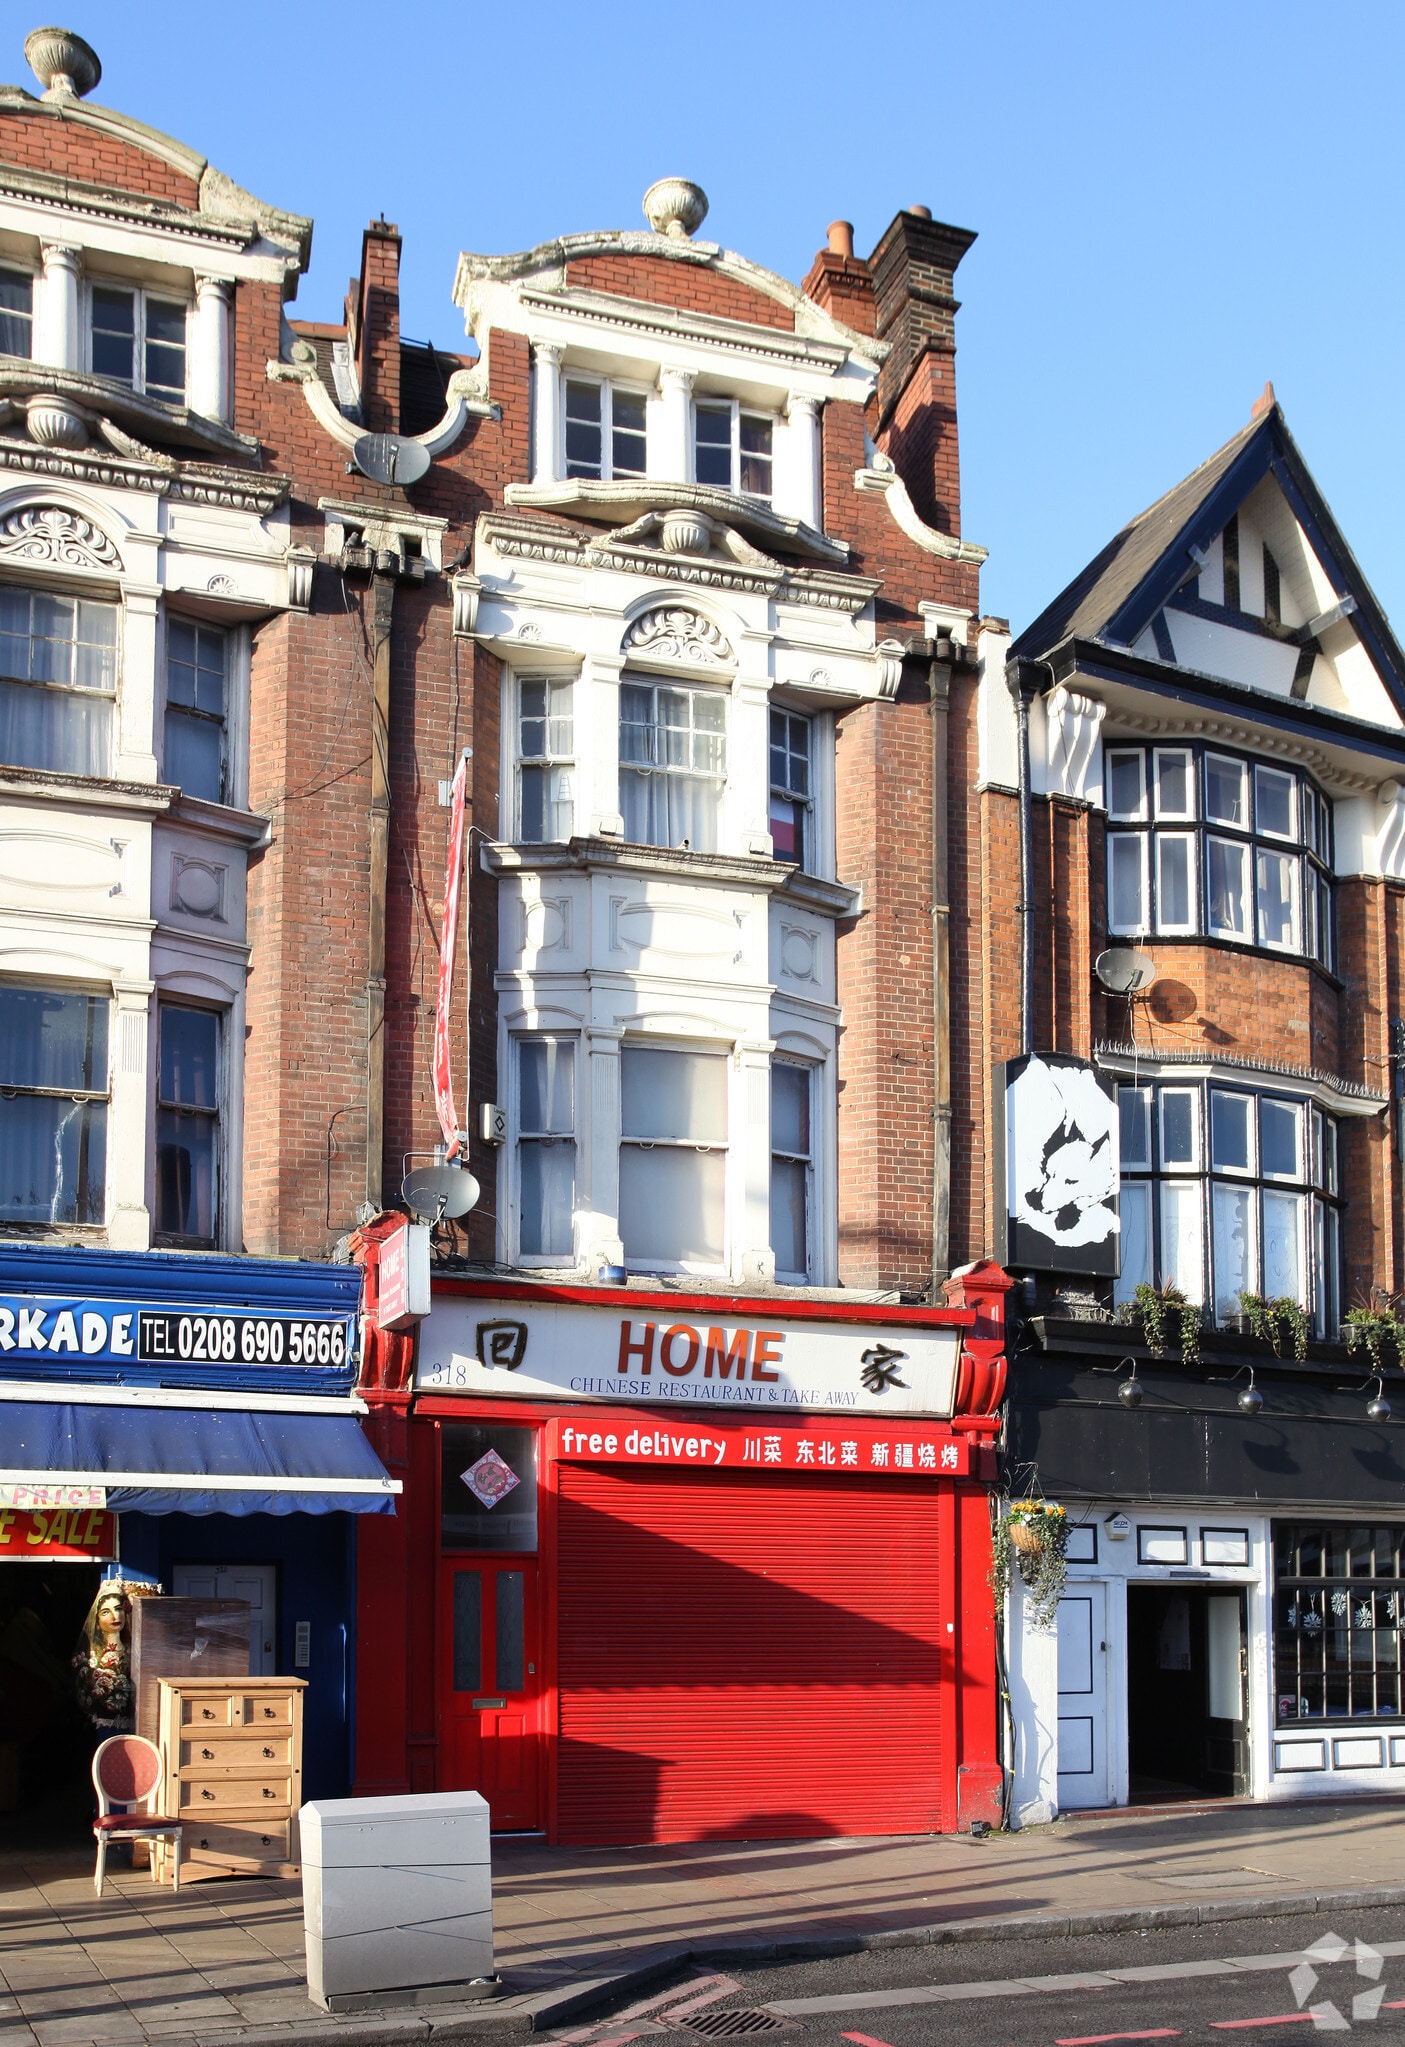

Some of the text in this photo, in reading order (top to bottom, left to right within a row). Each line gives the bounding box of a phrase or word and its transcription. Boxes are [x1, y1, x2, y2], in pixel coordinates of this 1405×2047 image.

[381, 1248, 400, 1283] HOME
[142, 1317, 345, 1365] TEL 0208 690 5666
[617, 1320, 784, 1382] HOME
[432, 1362, 467, 1386] 318
[860, 1342, 911, 1395] 家
[570, 1375, 859, 1406] CHINESE RESTAURANT & TAKE AWAY
[562, 1428, 727, 1464] free delivery
[742, 1435, 959, 1470] 川菜 东北菜 新疆烧烤
[12, 1487, 102, 1505] PRICE
[27, 1508, 104, 1545] SALE
